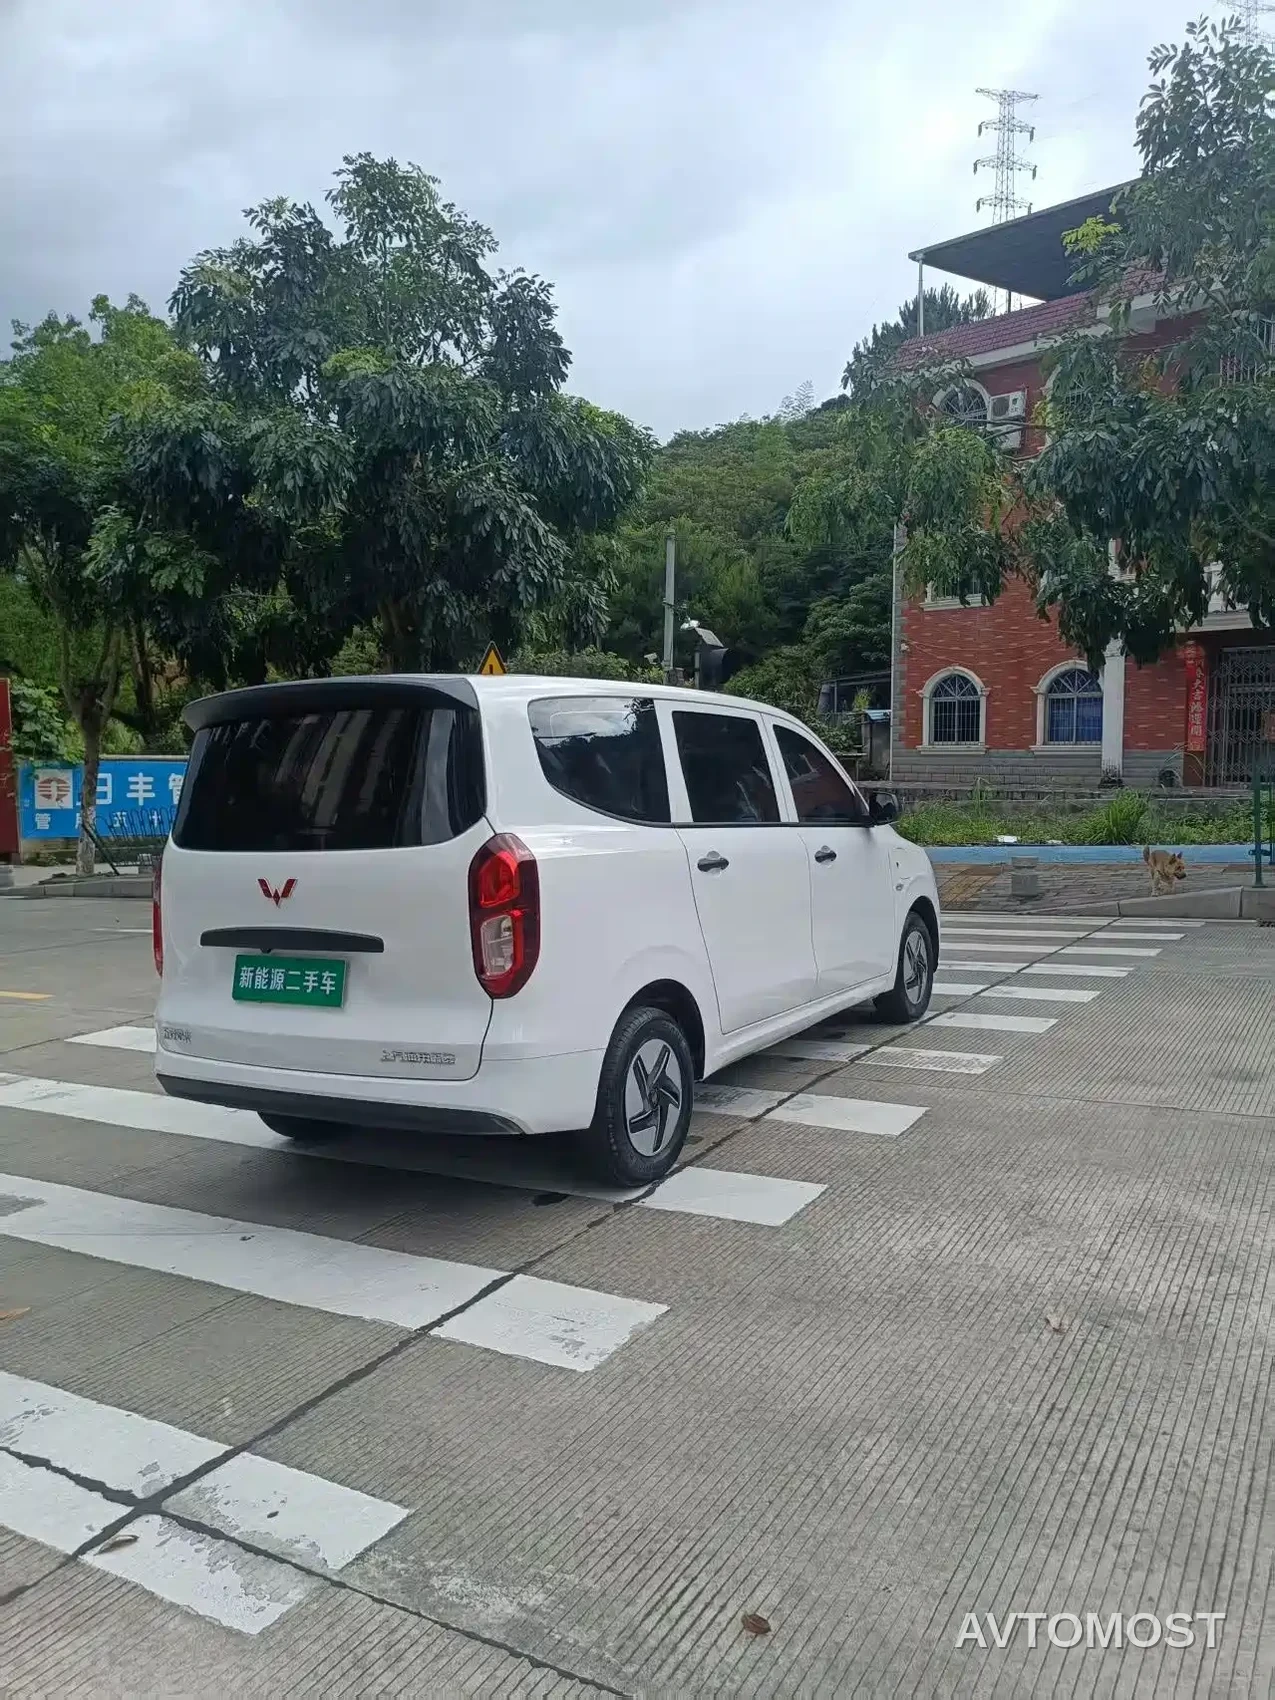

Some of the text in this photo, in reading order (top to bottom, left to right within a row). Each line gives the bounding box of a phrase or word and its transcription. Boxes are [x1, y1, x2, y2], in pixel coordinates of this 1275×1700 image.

[238, 966, 337, 995] 新能源二手车
